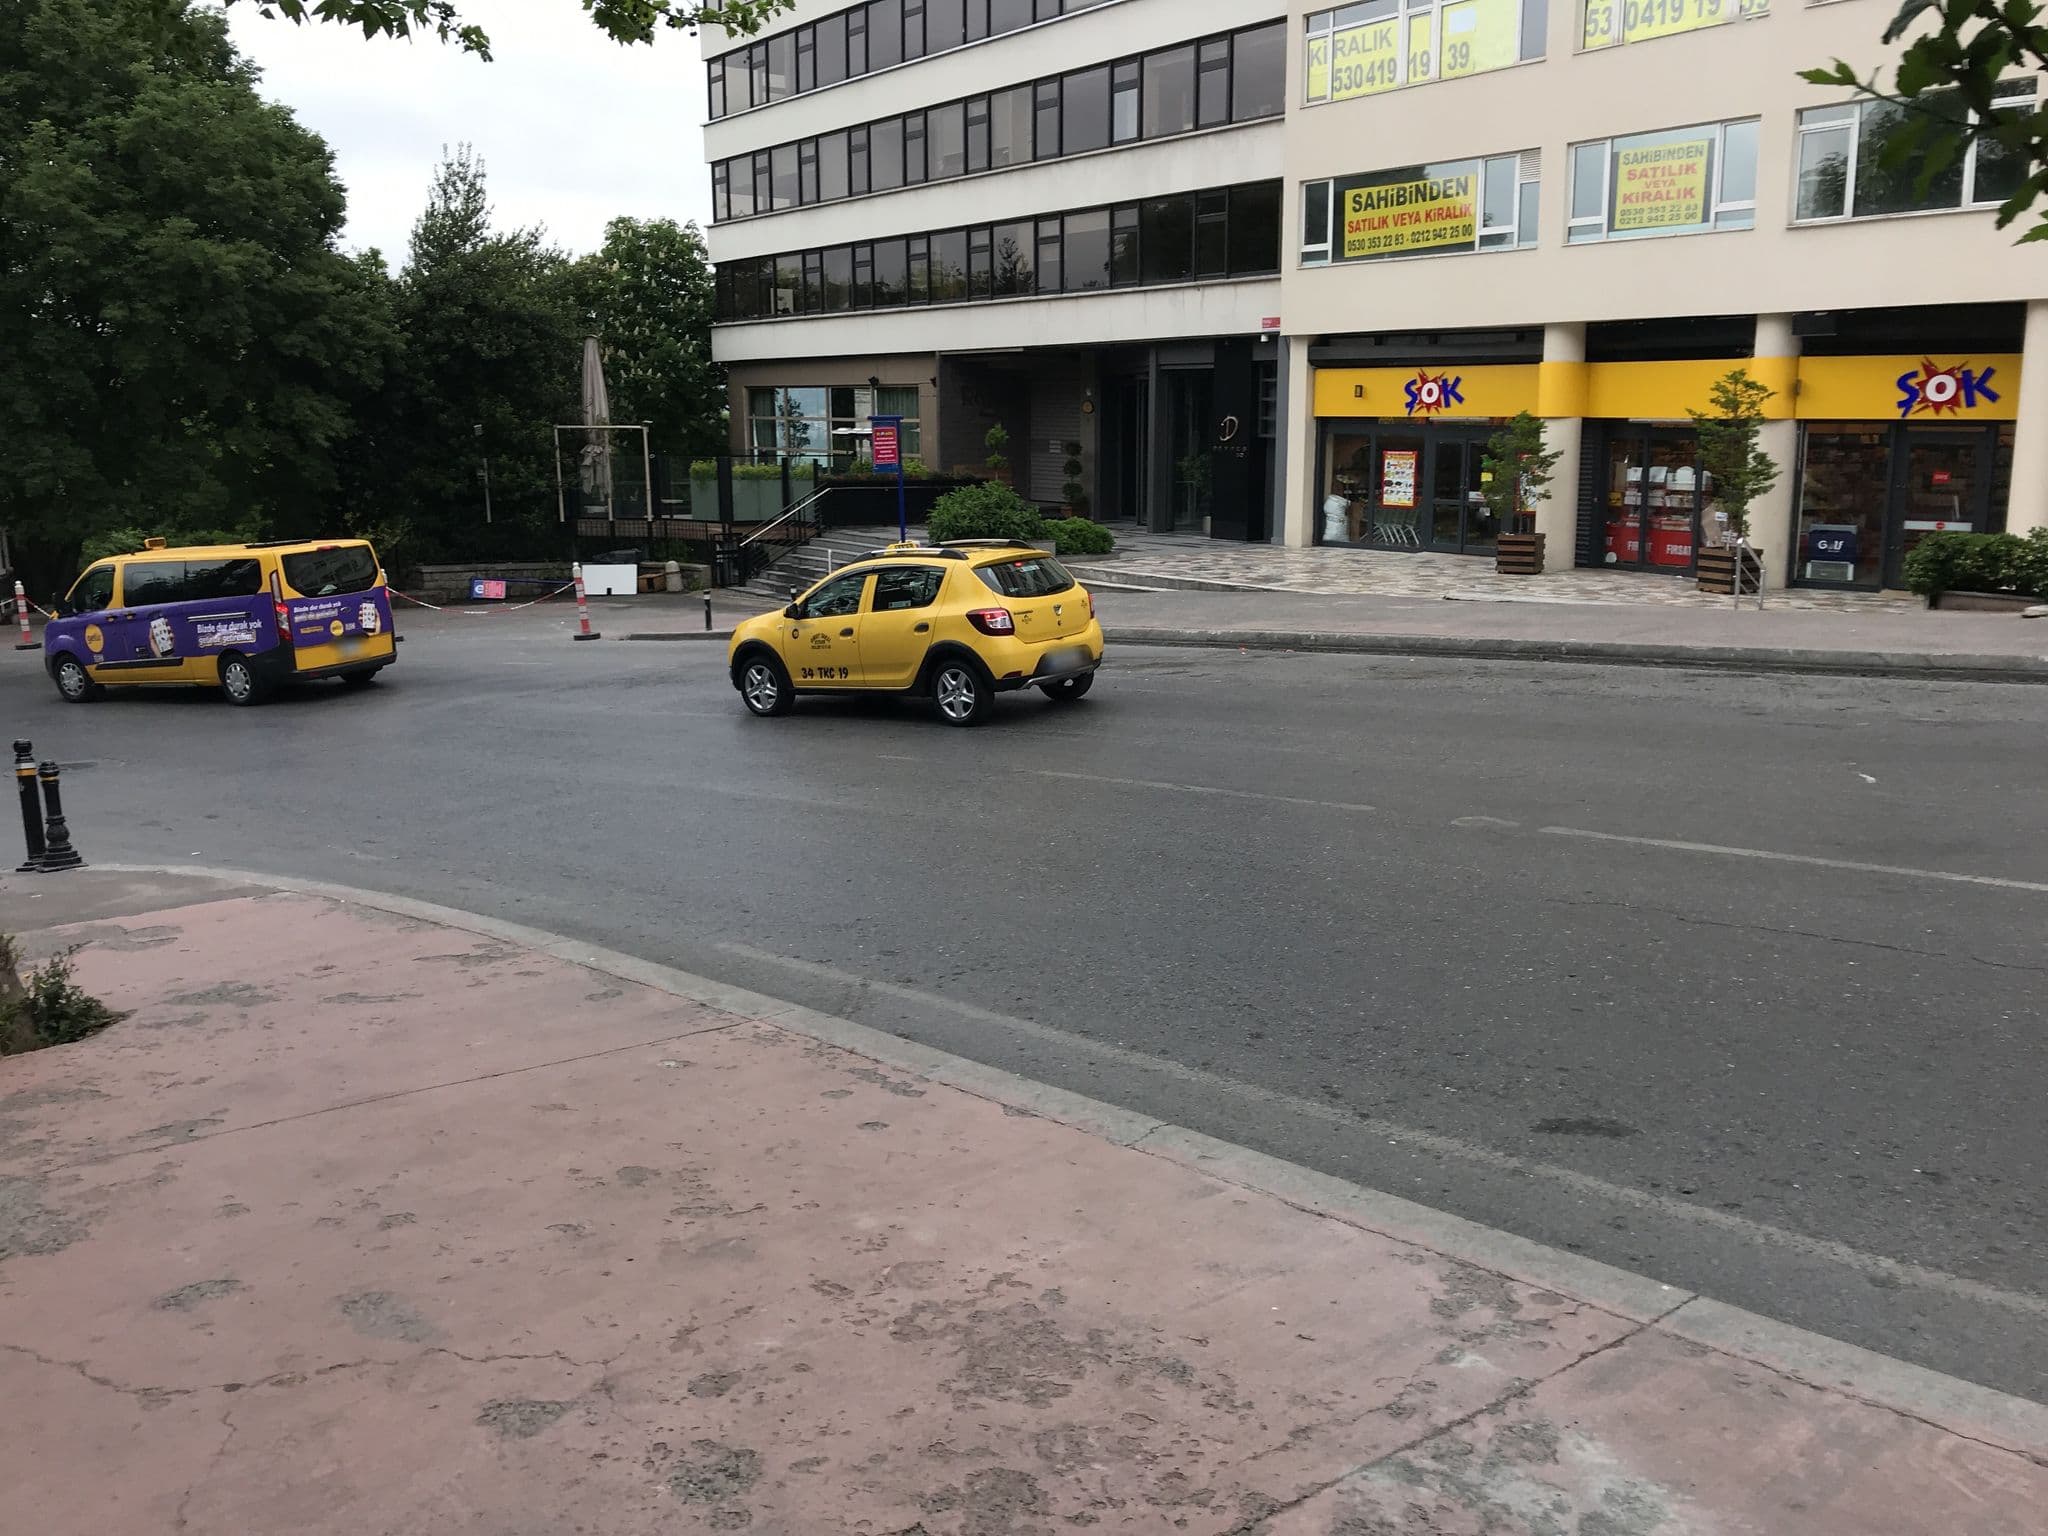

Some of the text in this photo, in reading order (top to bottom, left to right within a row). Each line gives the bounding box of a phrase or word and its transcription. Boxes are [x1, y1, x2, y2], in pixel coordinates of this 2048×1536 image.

[1409, 50, 1431, 79] 19
[1447, 41, 1470, 71] 39
[1627, 163, 1697, 181] SATILIK
[1644, 179, 1676, 189] VEYA
[1619, 212, 1697, 225] 0212 942 25 00
[1620, 207, 1645, 217] 0530
[1647, 205, 1666, 214] 353
[1669, 204, 1681, 212] 22
[1347, 215, 1389, 234] SATILIK
[1392, 211, 1421, 227] VEYA
[1347, 239, 1366, 252] 0530
[1367, 236, 1381, 249] 353
[1383, 235, 1393, 247] 22
[1410, 231, 1431, 243] 0212
[1432, 227, 1447, 240] 942
[1449, 225, 1460, 239] 25
[1461, 224, 1473, 237] 00
[1404, 376, 1465, 416] ŞOK
[1896, 366, 2001, 418] ŞOK
[801, 666, 849, 679] 34 TKC 19
